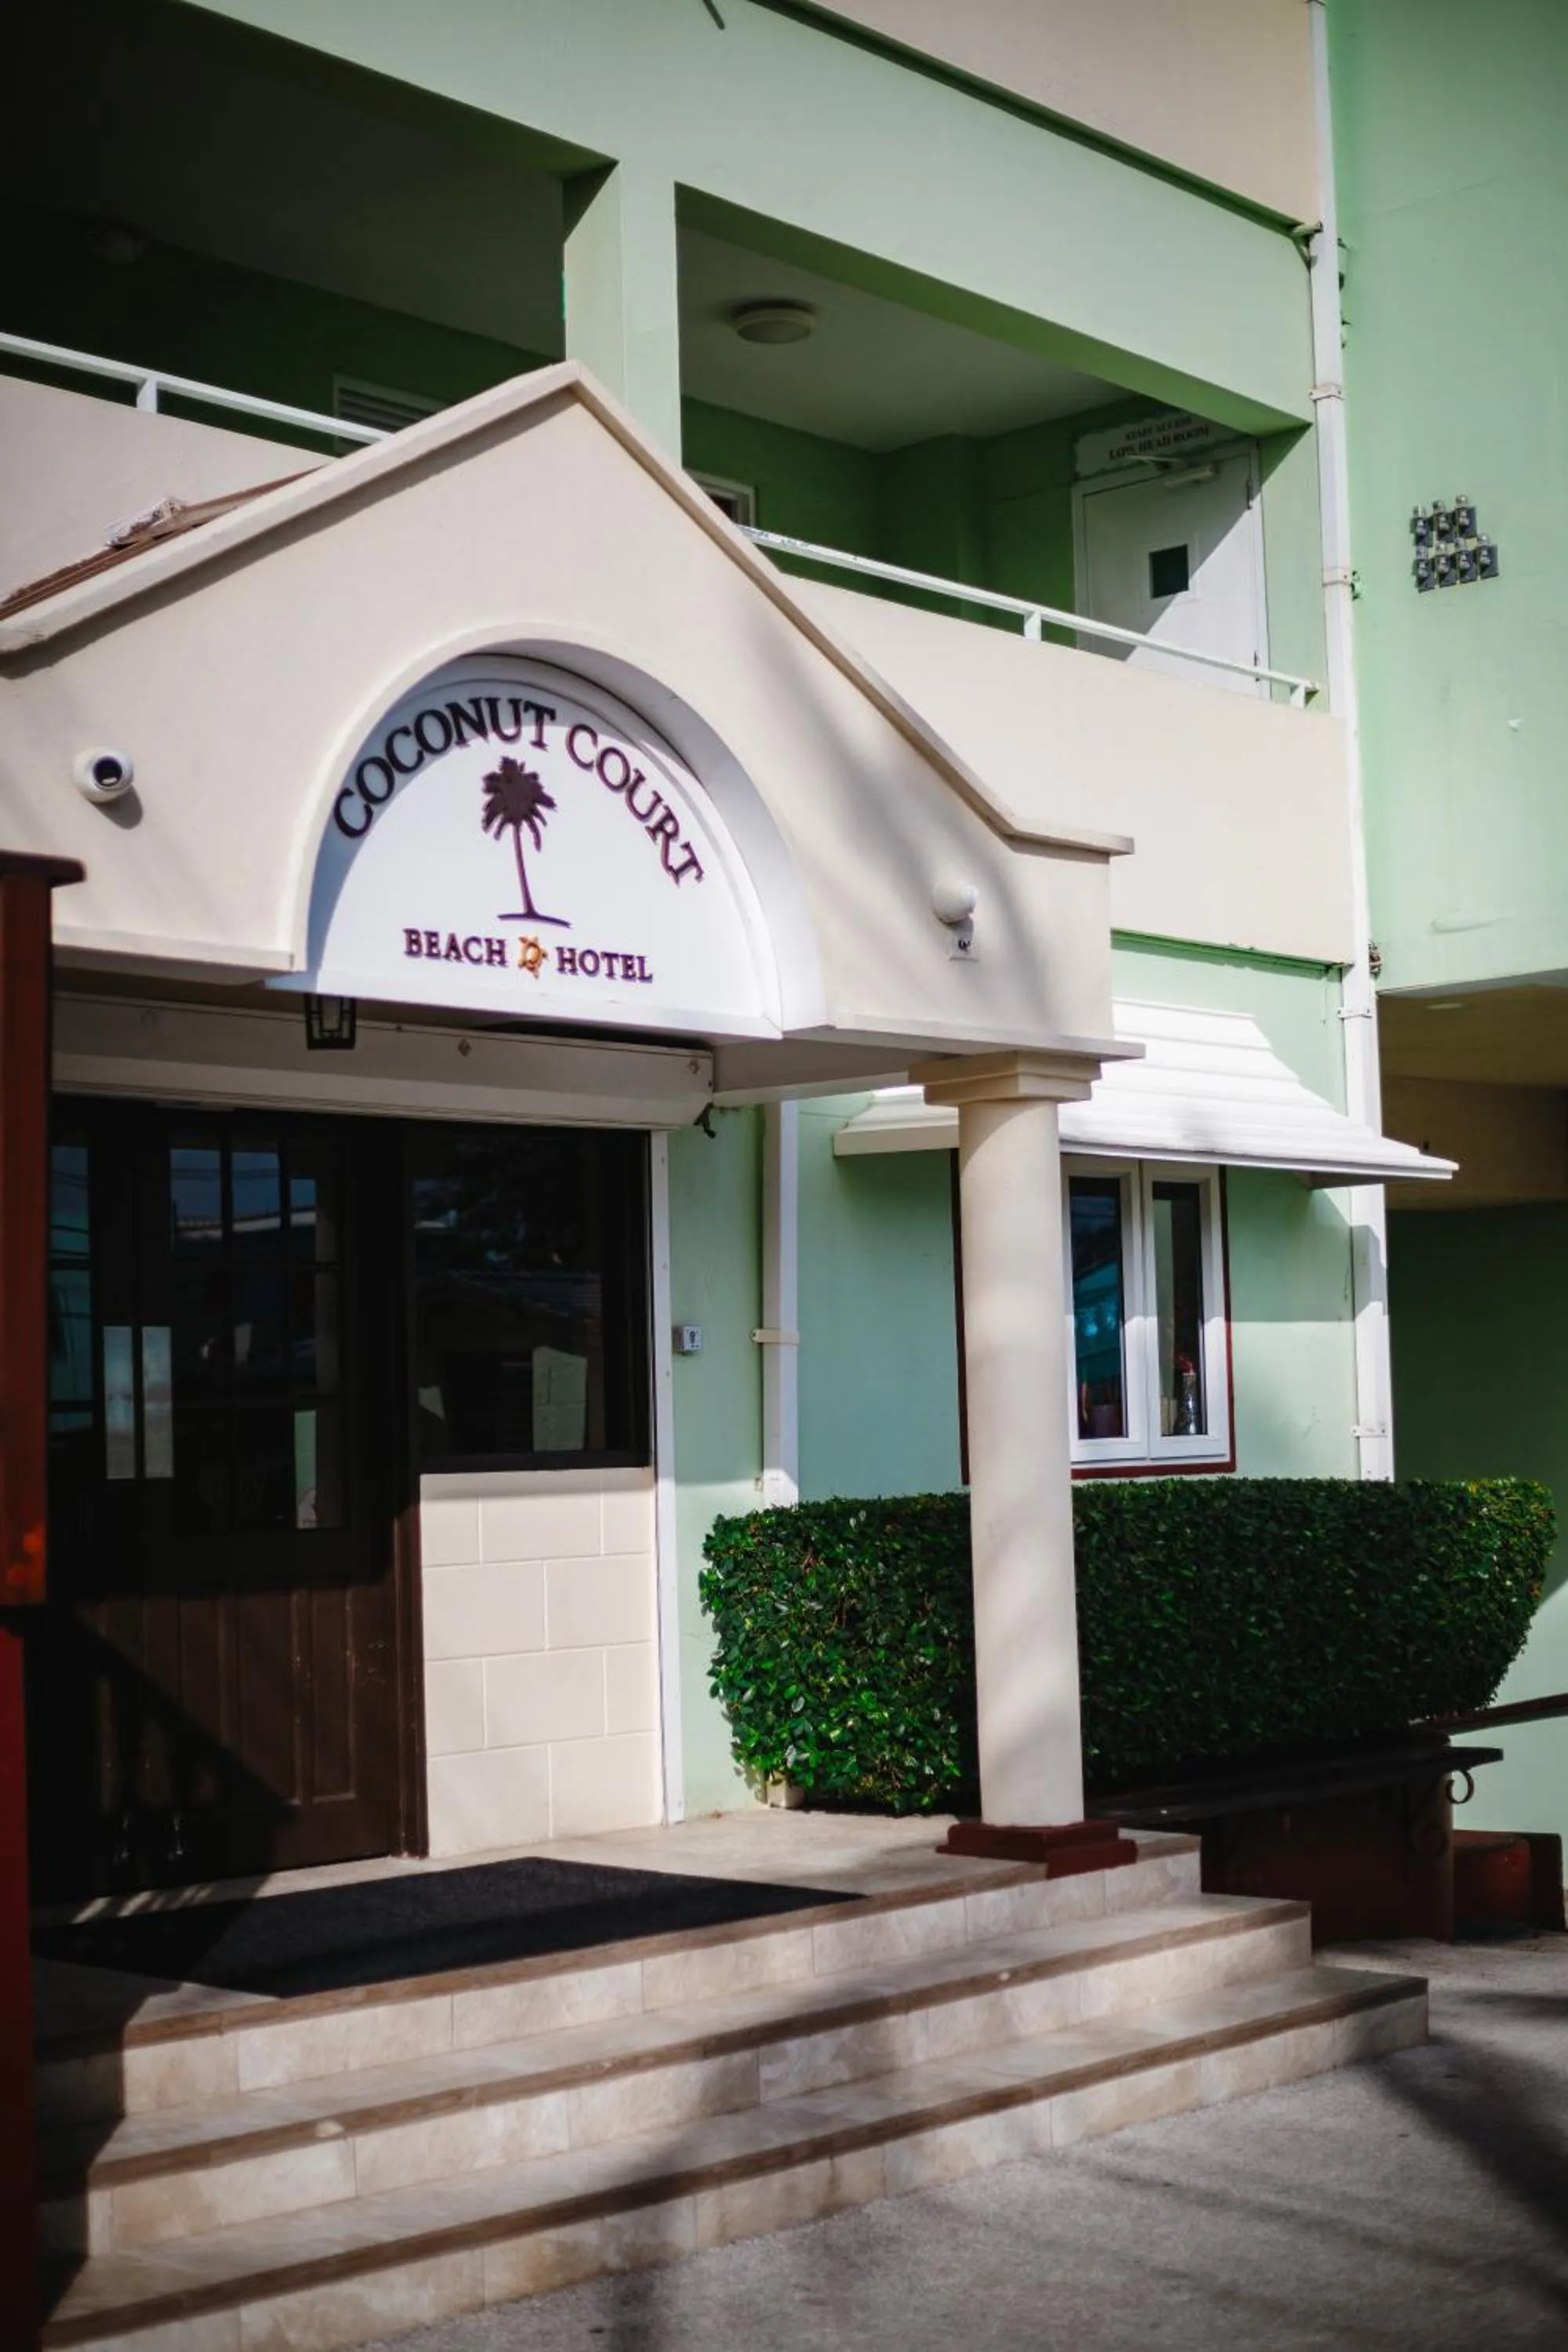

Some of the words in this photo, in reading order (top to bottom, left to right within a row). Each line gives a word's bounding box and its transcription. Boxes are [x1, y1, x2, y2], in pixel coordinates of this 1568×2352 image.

[333, 697, 556, 839] COCONUT
[566, 723, 704, 886] COURT
[403, 927, 507, 967] BEACH
[556, 946, 653, 983] HOTEL
